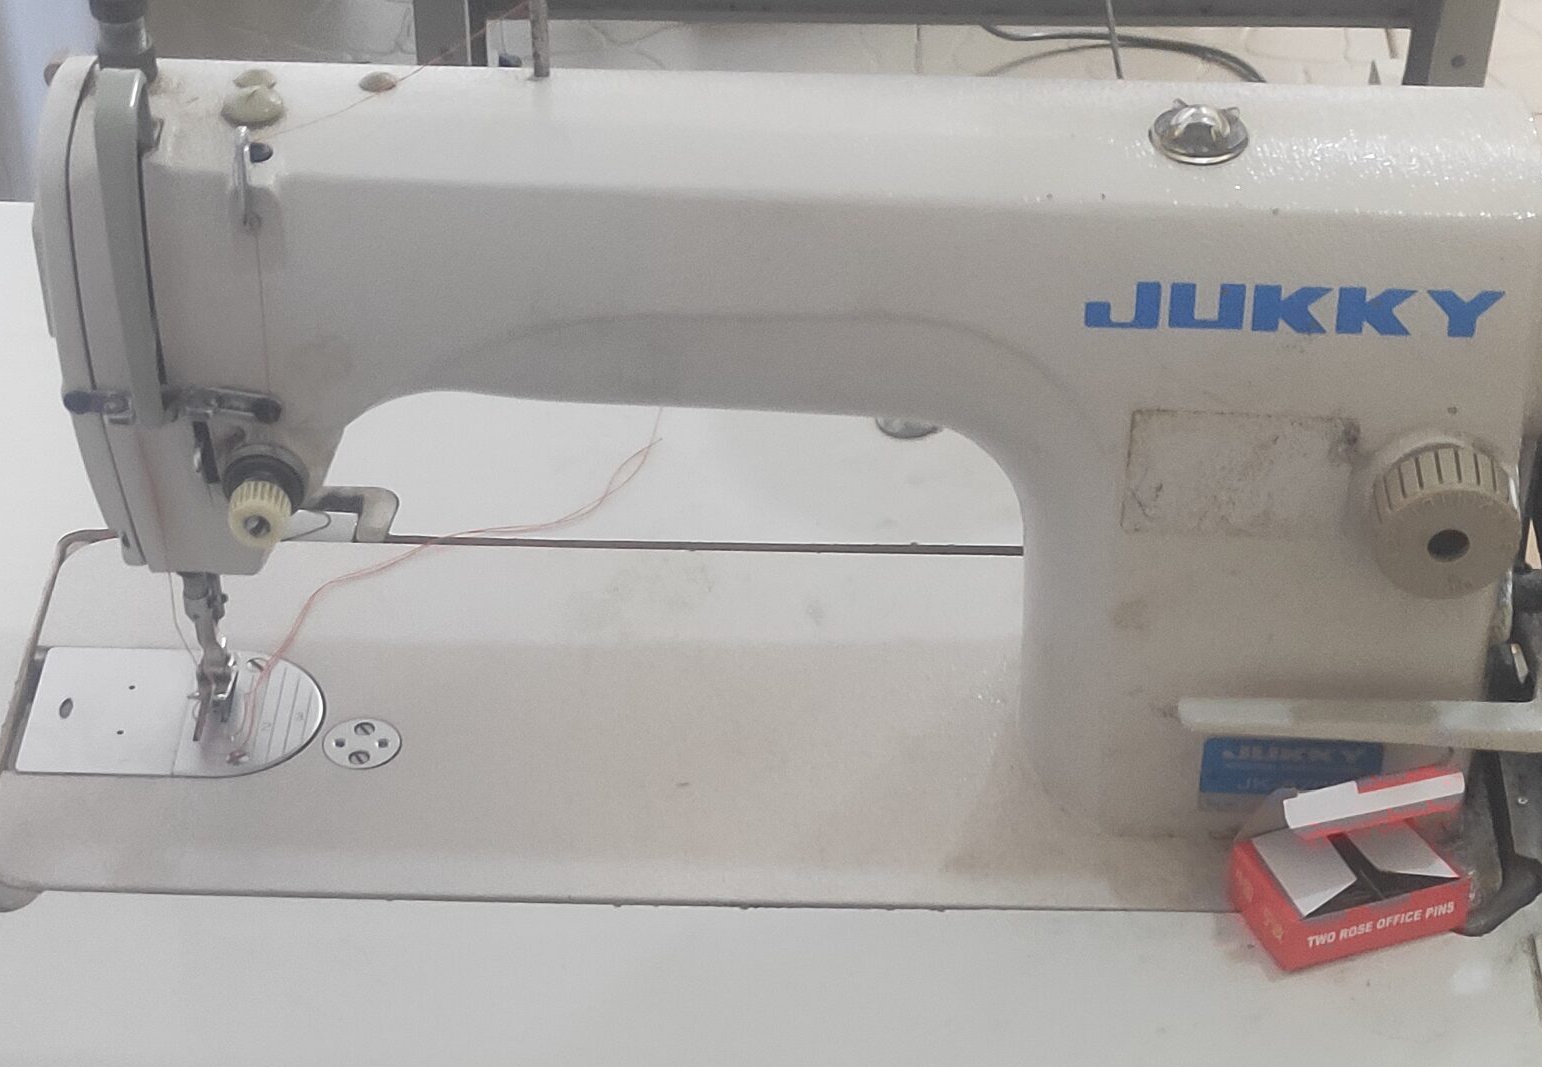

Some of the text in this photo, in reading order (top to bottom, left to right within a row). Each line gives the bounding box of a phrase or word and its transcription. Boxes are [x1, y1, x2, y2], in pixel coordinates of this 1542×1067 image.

[1084, 281, 1506, 338] JUKKY
[1307, 902, 1454, 948] TWO ROSE OFFICE PINS
